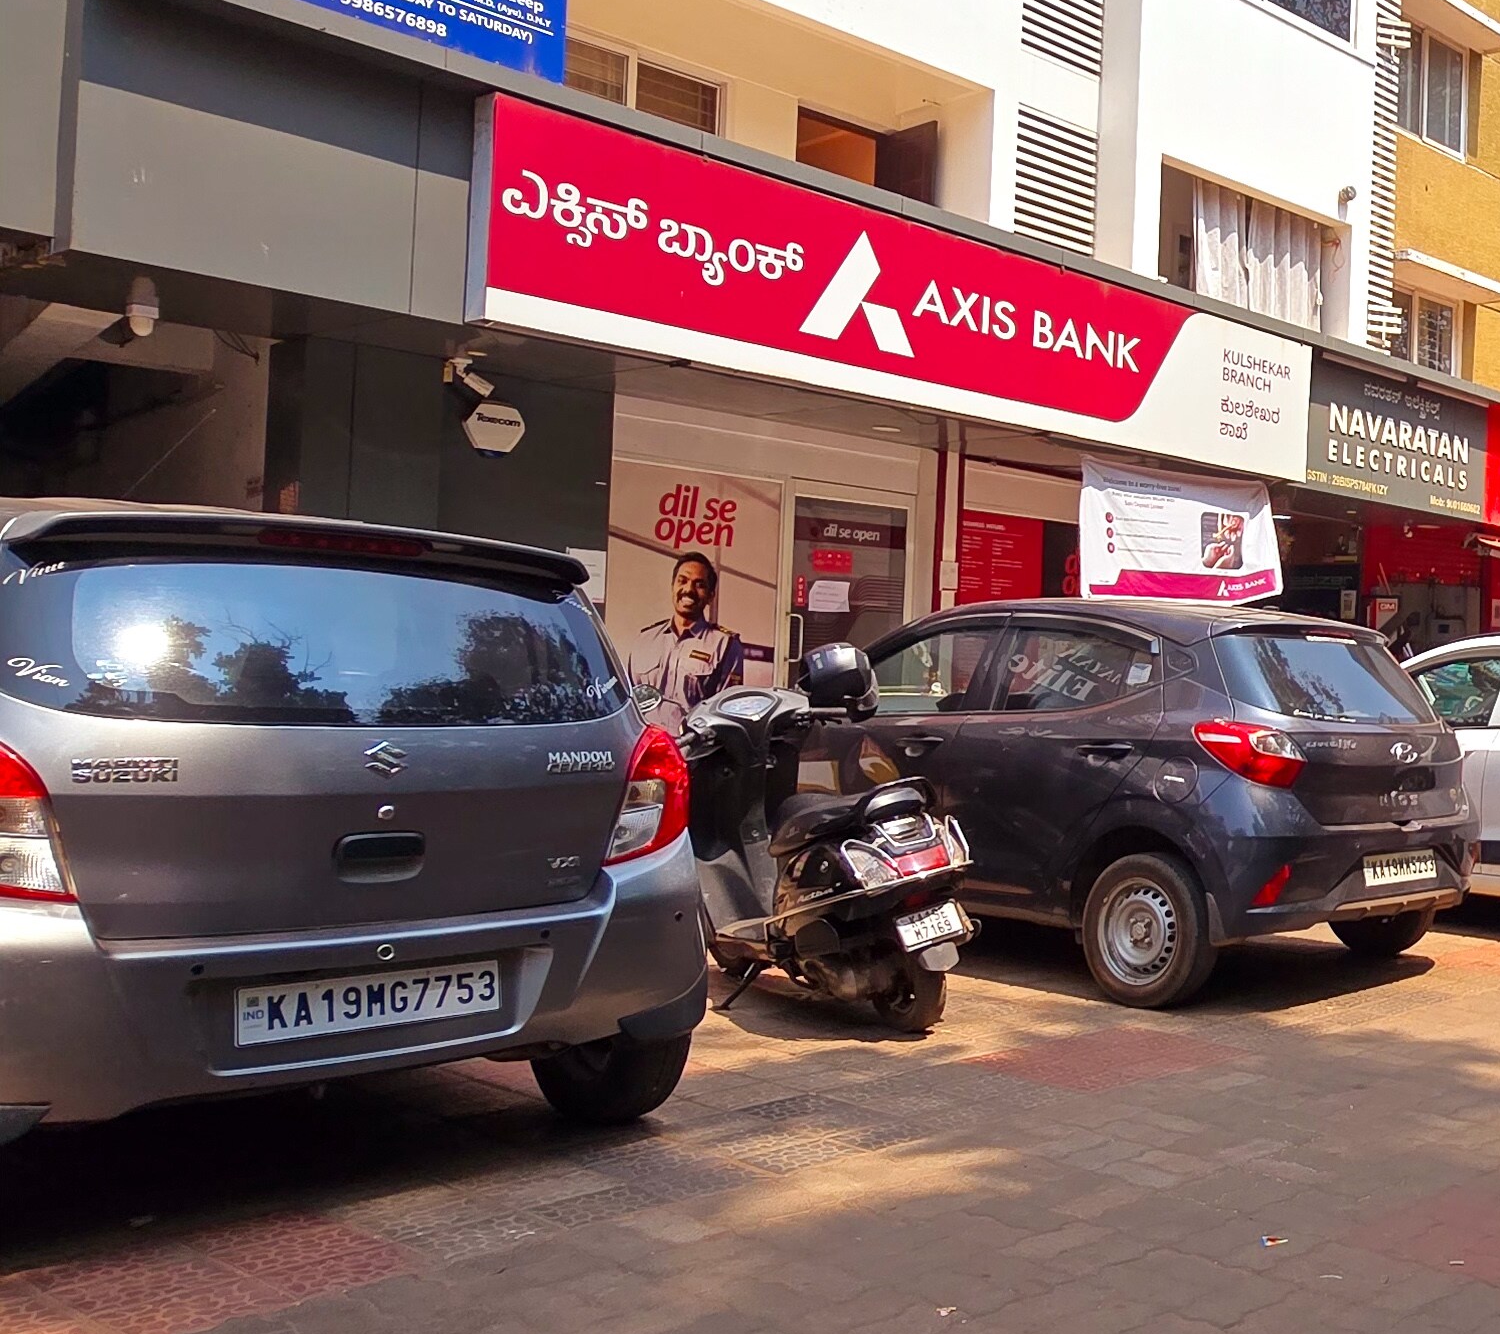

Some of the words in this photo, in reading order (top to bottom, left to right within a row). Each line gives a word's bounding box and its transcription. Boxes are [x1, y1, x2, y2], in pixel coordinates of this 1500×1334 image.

[437, 0, 456, 17] TO
[459, 8, 534, 45] SATURDAY)
[657, 217, 806, 287] ಬ್ಯಾಂಕ್
[912, 279, 1017, 341] AXIS
[1032, 309, 1141, 373] BANK
[1222, 366, 1272, 393] BRANCH
[1223, 348, 1291, 381] KULSHEKAR
[1220, 395, 1281, 424] ಕುಲಶೇಖರ
[1219, 421, 1249, 441] ಶಾಖೆ
[1329, 402, 1470, 465] NAVARATAN
[1306, 469, 1328, 483] GSTIN
[1327, 438, 1469, 491] ELECTRICALS
[658, 483, 700, 519] dil
[704, 495, 738, 523] se
[654, 518, 735, 549] open
[823, 523, 838, 537] dil
[839, 528, 851, 538] se
[853, 529, 880, 542] open
[71, 756, 179, 769] MARUTI
[548, 750, 613, 762] MANDOVI
[71, 768, 178, 784] SUZUKI
[242, 1009, 265, 1021] IND
[267, 970, 496, 1031] KA19MG7753
